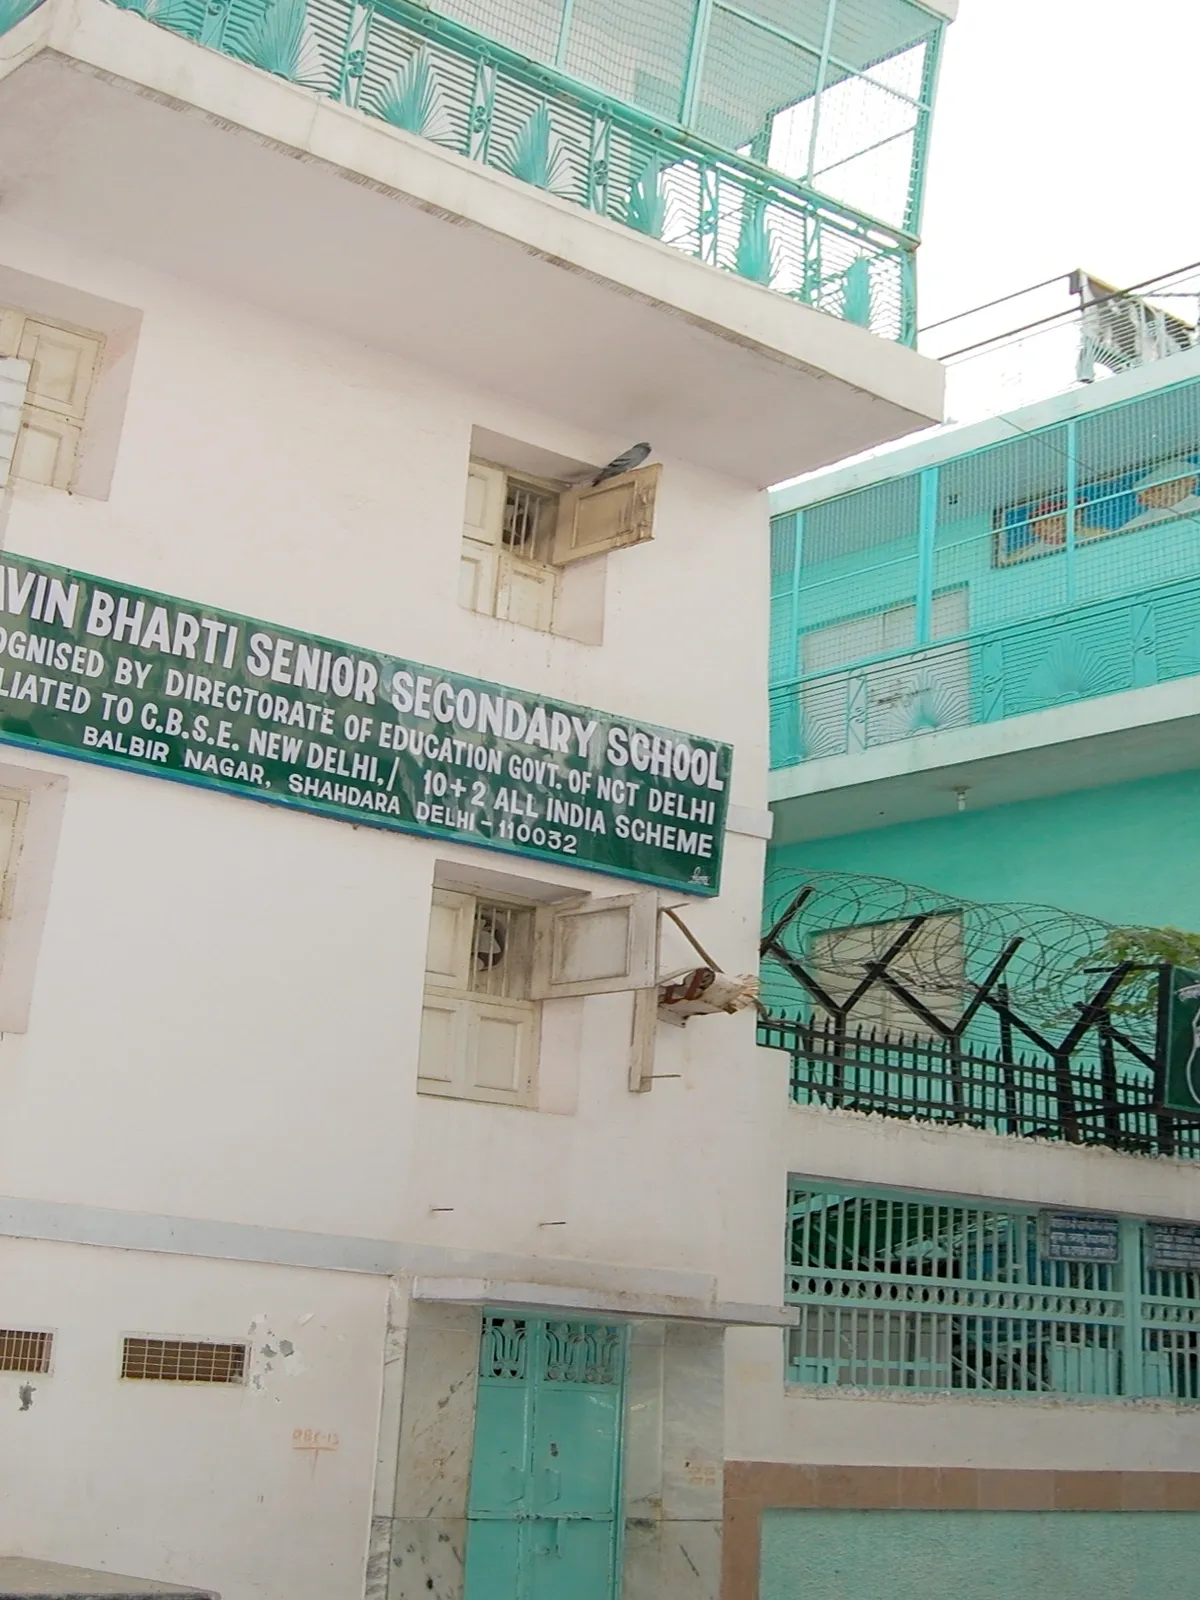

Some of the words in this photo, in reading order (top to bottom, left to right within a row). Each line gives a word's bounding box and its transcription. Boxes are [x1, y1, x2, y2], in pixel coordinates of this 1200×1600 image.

[86, 589, 239, 669] BHARTI
[247, 633, 379, 705] SENIOR
[391, 671, 600, 758] SECONDARY
[606, 727, 724, 791] SCHOOL
[115, 660, 153, 689] BY
[165, 668, 336, 735] DIRECTORATE
[344, 715, 373, 743] OF
[379, 722, 502, 775] EDUCATION
[508, 755, 562, 791] GOVT.
[568, 769, 592, 795] OF
[597, 776, 639, 807] NCT
[648, 789, 715, 826] DELHI
[82, 725, 170, 764] BALBIR
[184, 748, 271, 789] NAGAR,
[288, 773, 401, 815] SHAHDARA
[415, 801, 475, 832] DELHI
[499, 820, 578, 854] 110032
[102, 692, 134, 725] TO
[140, 703, 240, 752] C.B.S.E.
[248, 729, 304, 764] NEW
[493, 787, 539, 819] ALL
[547, 797, 606, 835] INDIA
[615, 814, 714, 859] SCHEME
